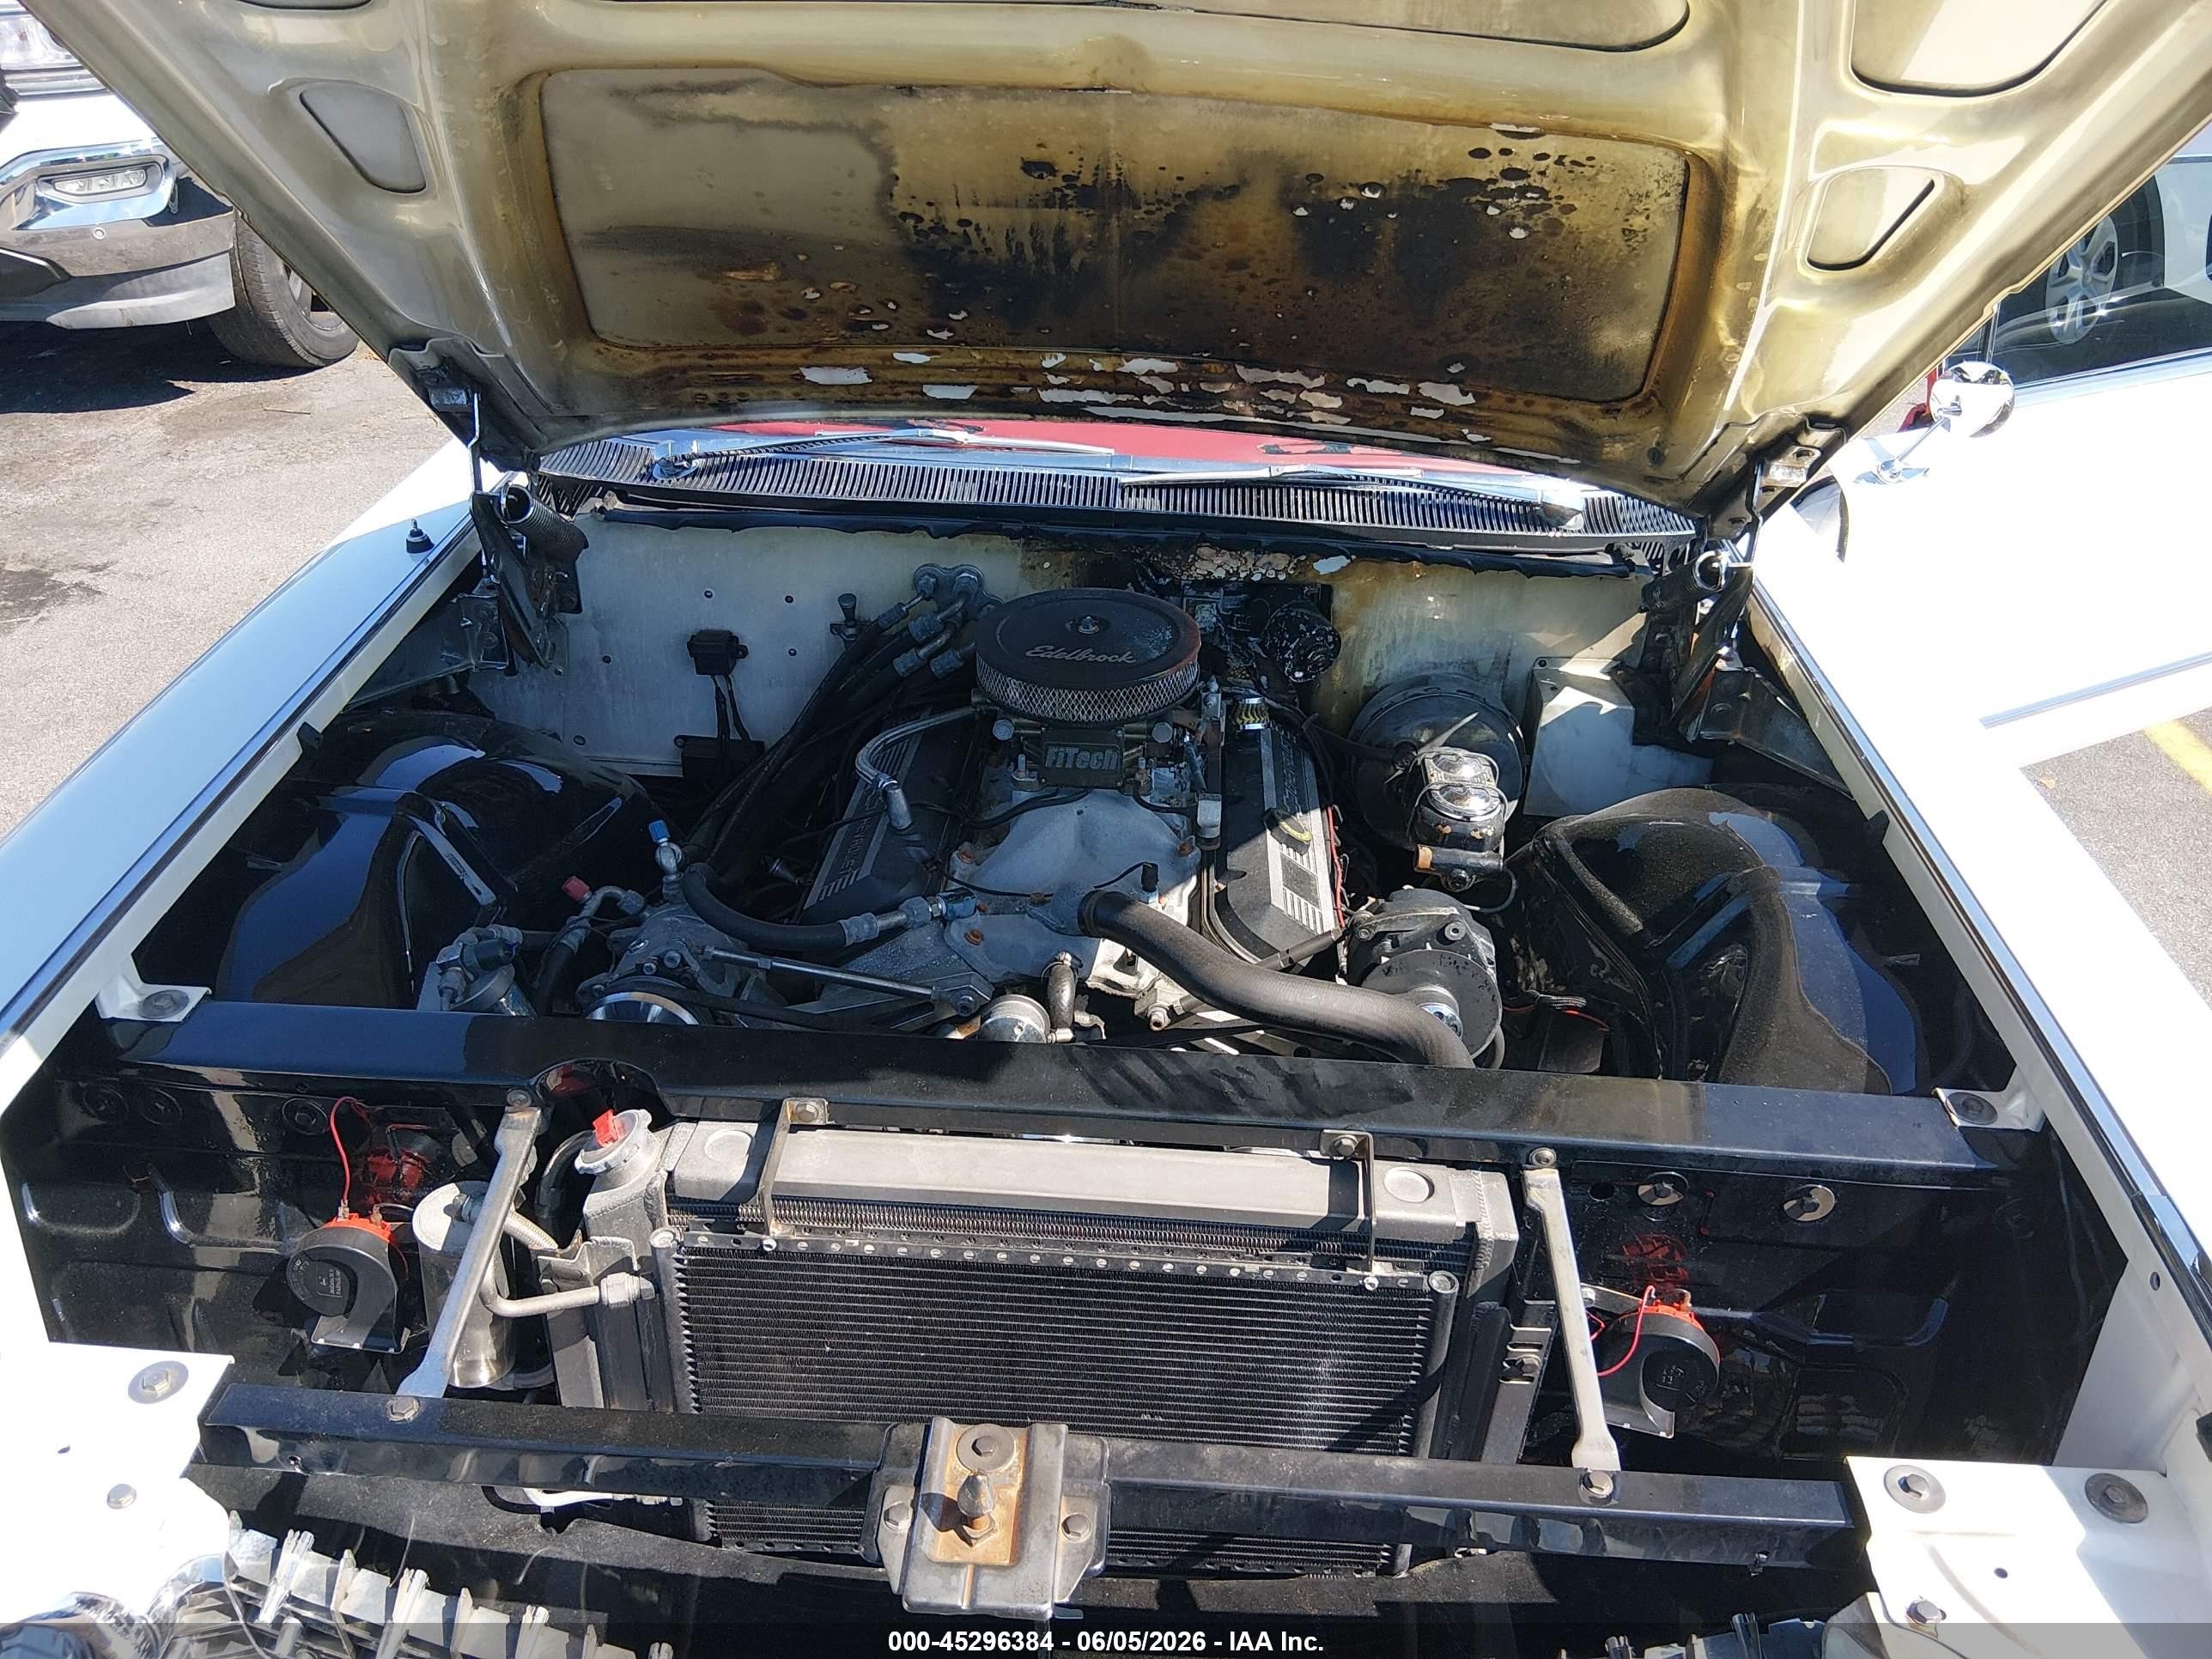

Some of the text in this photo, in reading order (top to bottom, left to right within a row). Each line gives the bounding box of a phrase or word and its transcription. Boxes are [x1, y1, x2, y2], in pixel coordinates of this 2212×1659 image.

[1025, 645, 1137, 664] Edelbrock
[1044, 746, 1120, 770] FiTech
[838, 814, 873, 876] HEVROLET
